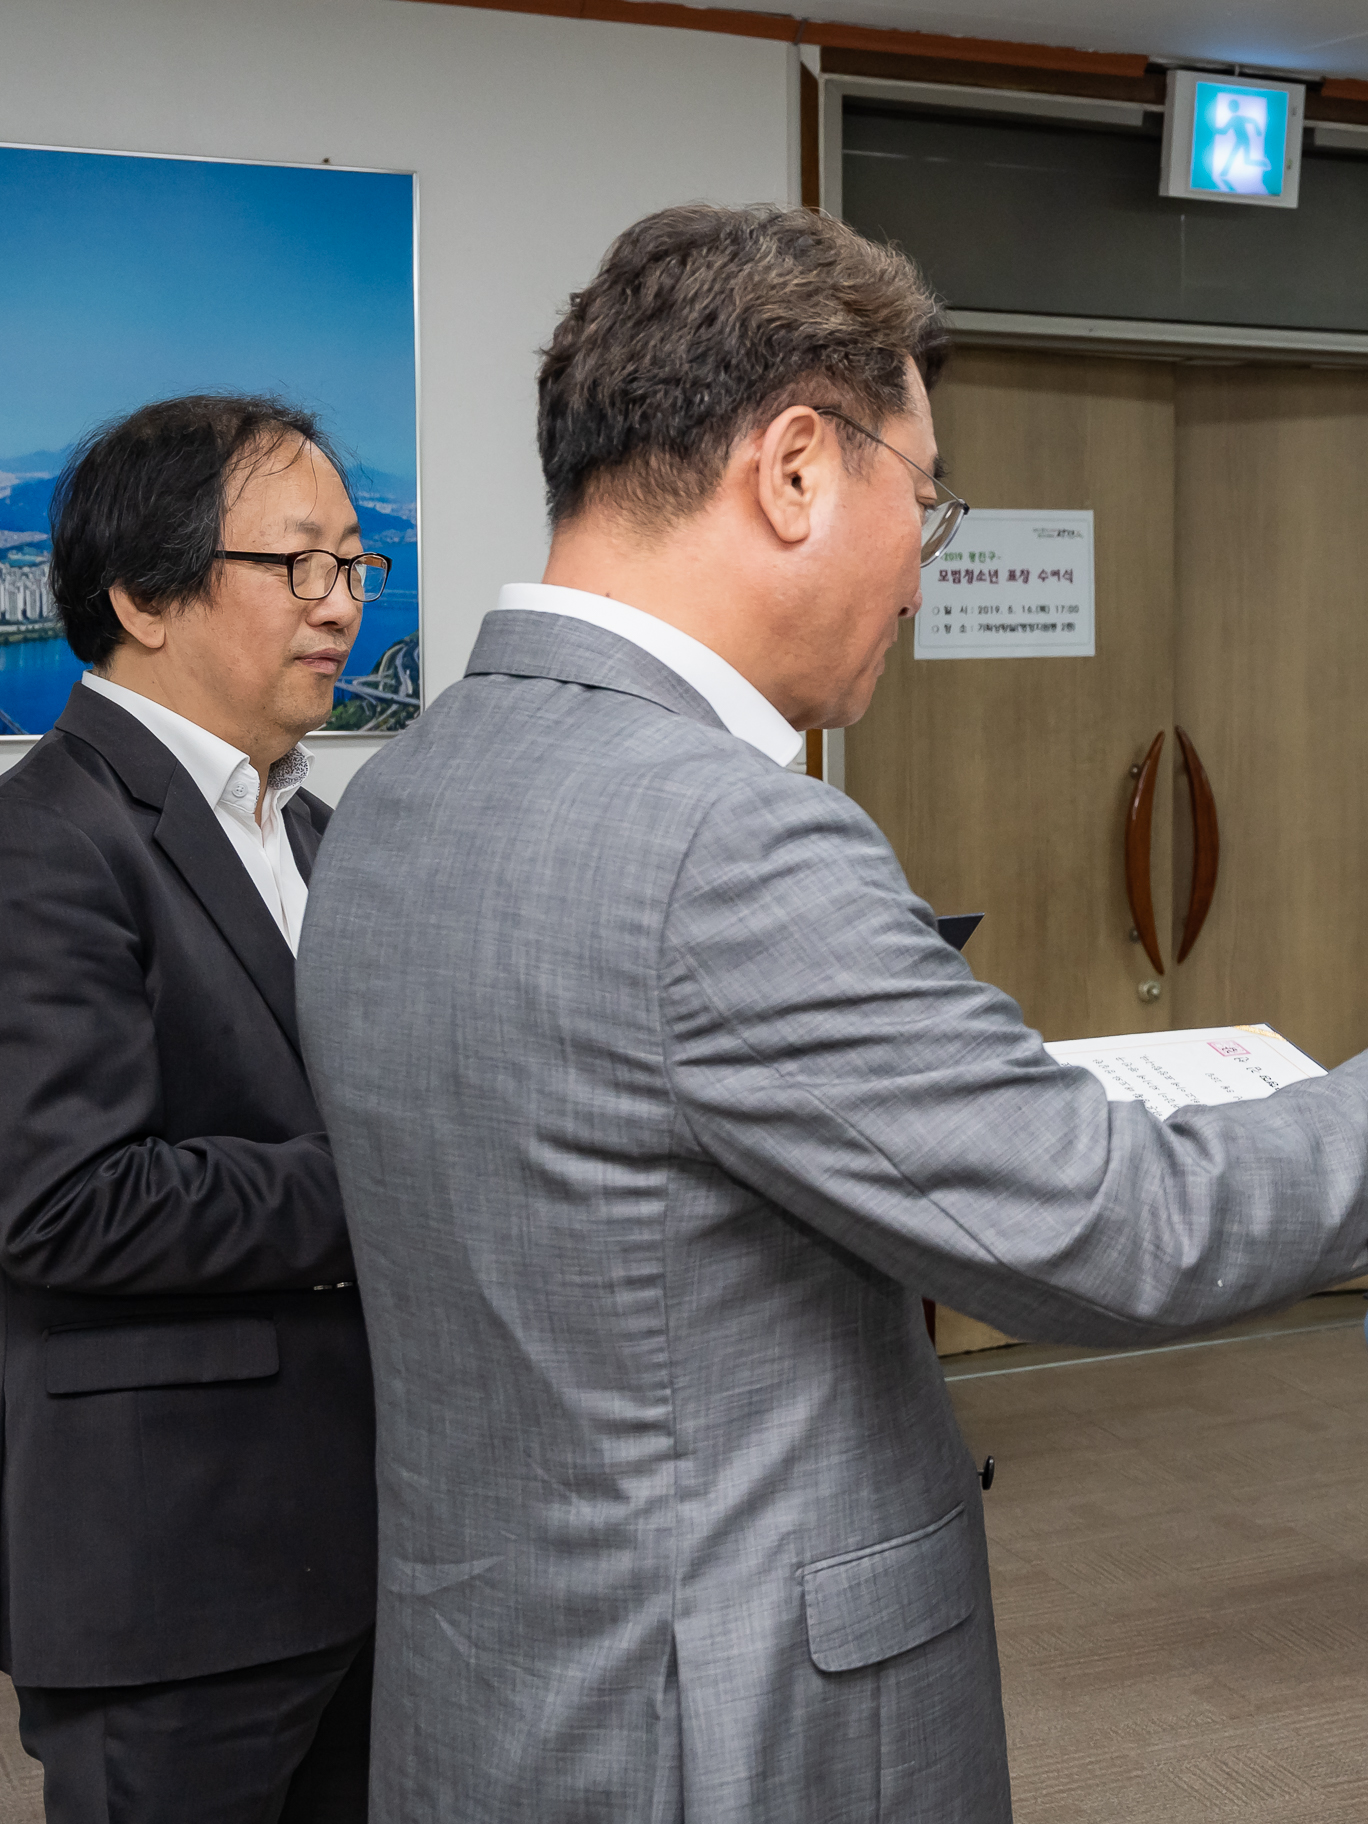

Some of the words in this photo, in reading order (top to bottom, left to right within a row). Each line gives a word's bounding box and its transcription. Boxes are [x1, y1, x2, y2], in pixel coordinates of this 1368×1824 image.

[938, 569, 999, 584] 모범청소년
[1006, 569, 1030, 584] 표창
[1037, 568, 1074, 584] 수여식
